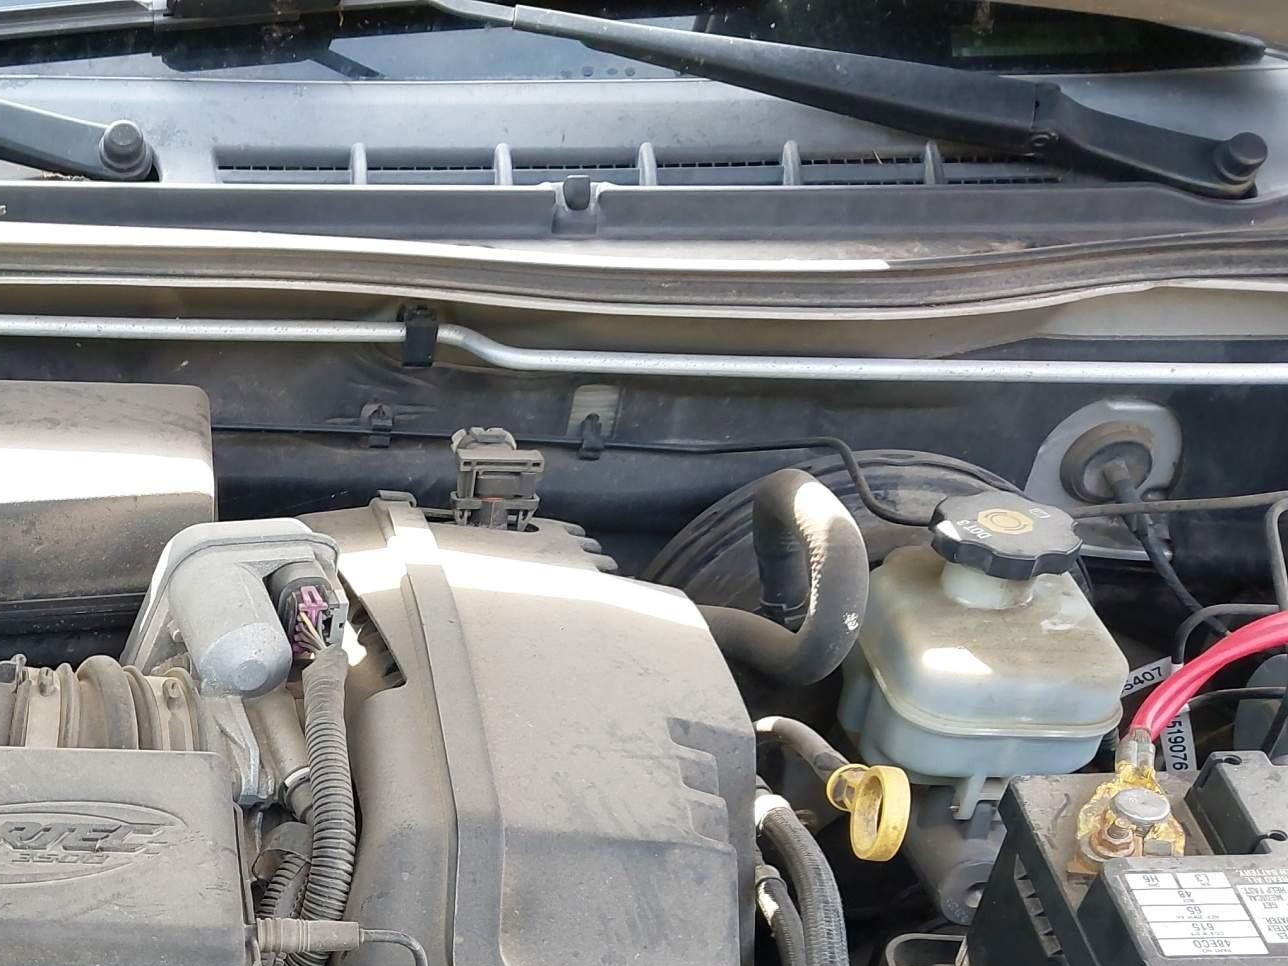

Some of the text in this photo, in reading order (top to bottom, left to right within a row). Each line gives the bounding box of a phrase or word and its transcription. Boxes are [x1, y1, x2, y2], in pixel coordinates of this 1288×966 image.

[963, 524, 993, 539] DOT
[1166, 715, 1189, 771] 519076
[1142, 874, 1160, 883] H6
[1186, 906, 1202, 915] 65
[1191, 922, 1215, 931] 615
